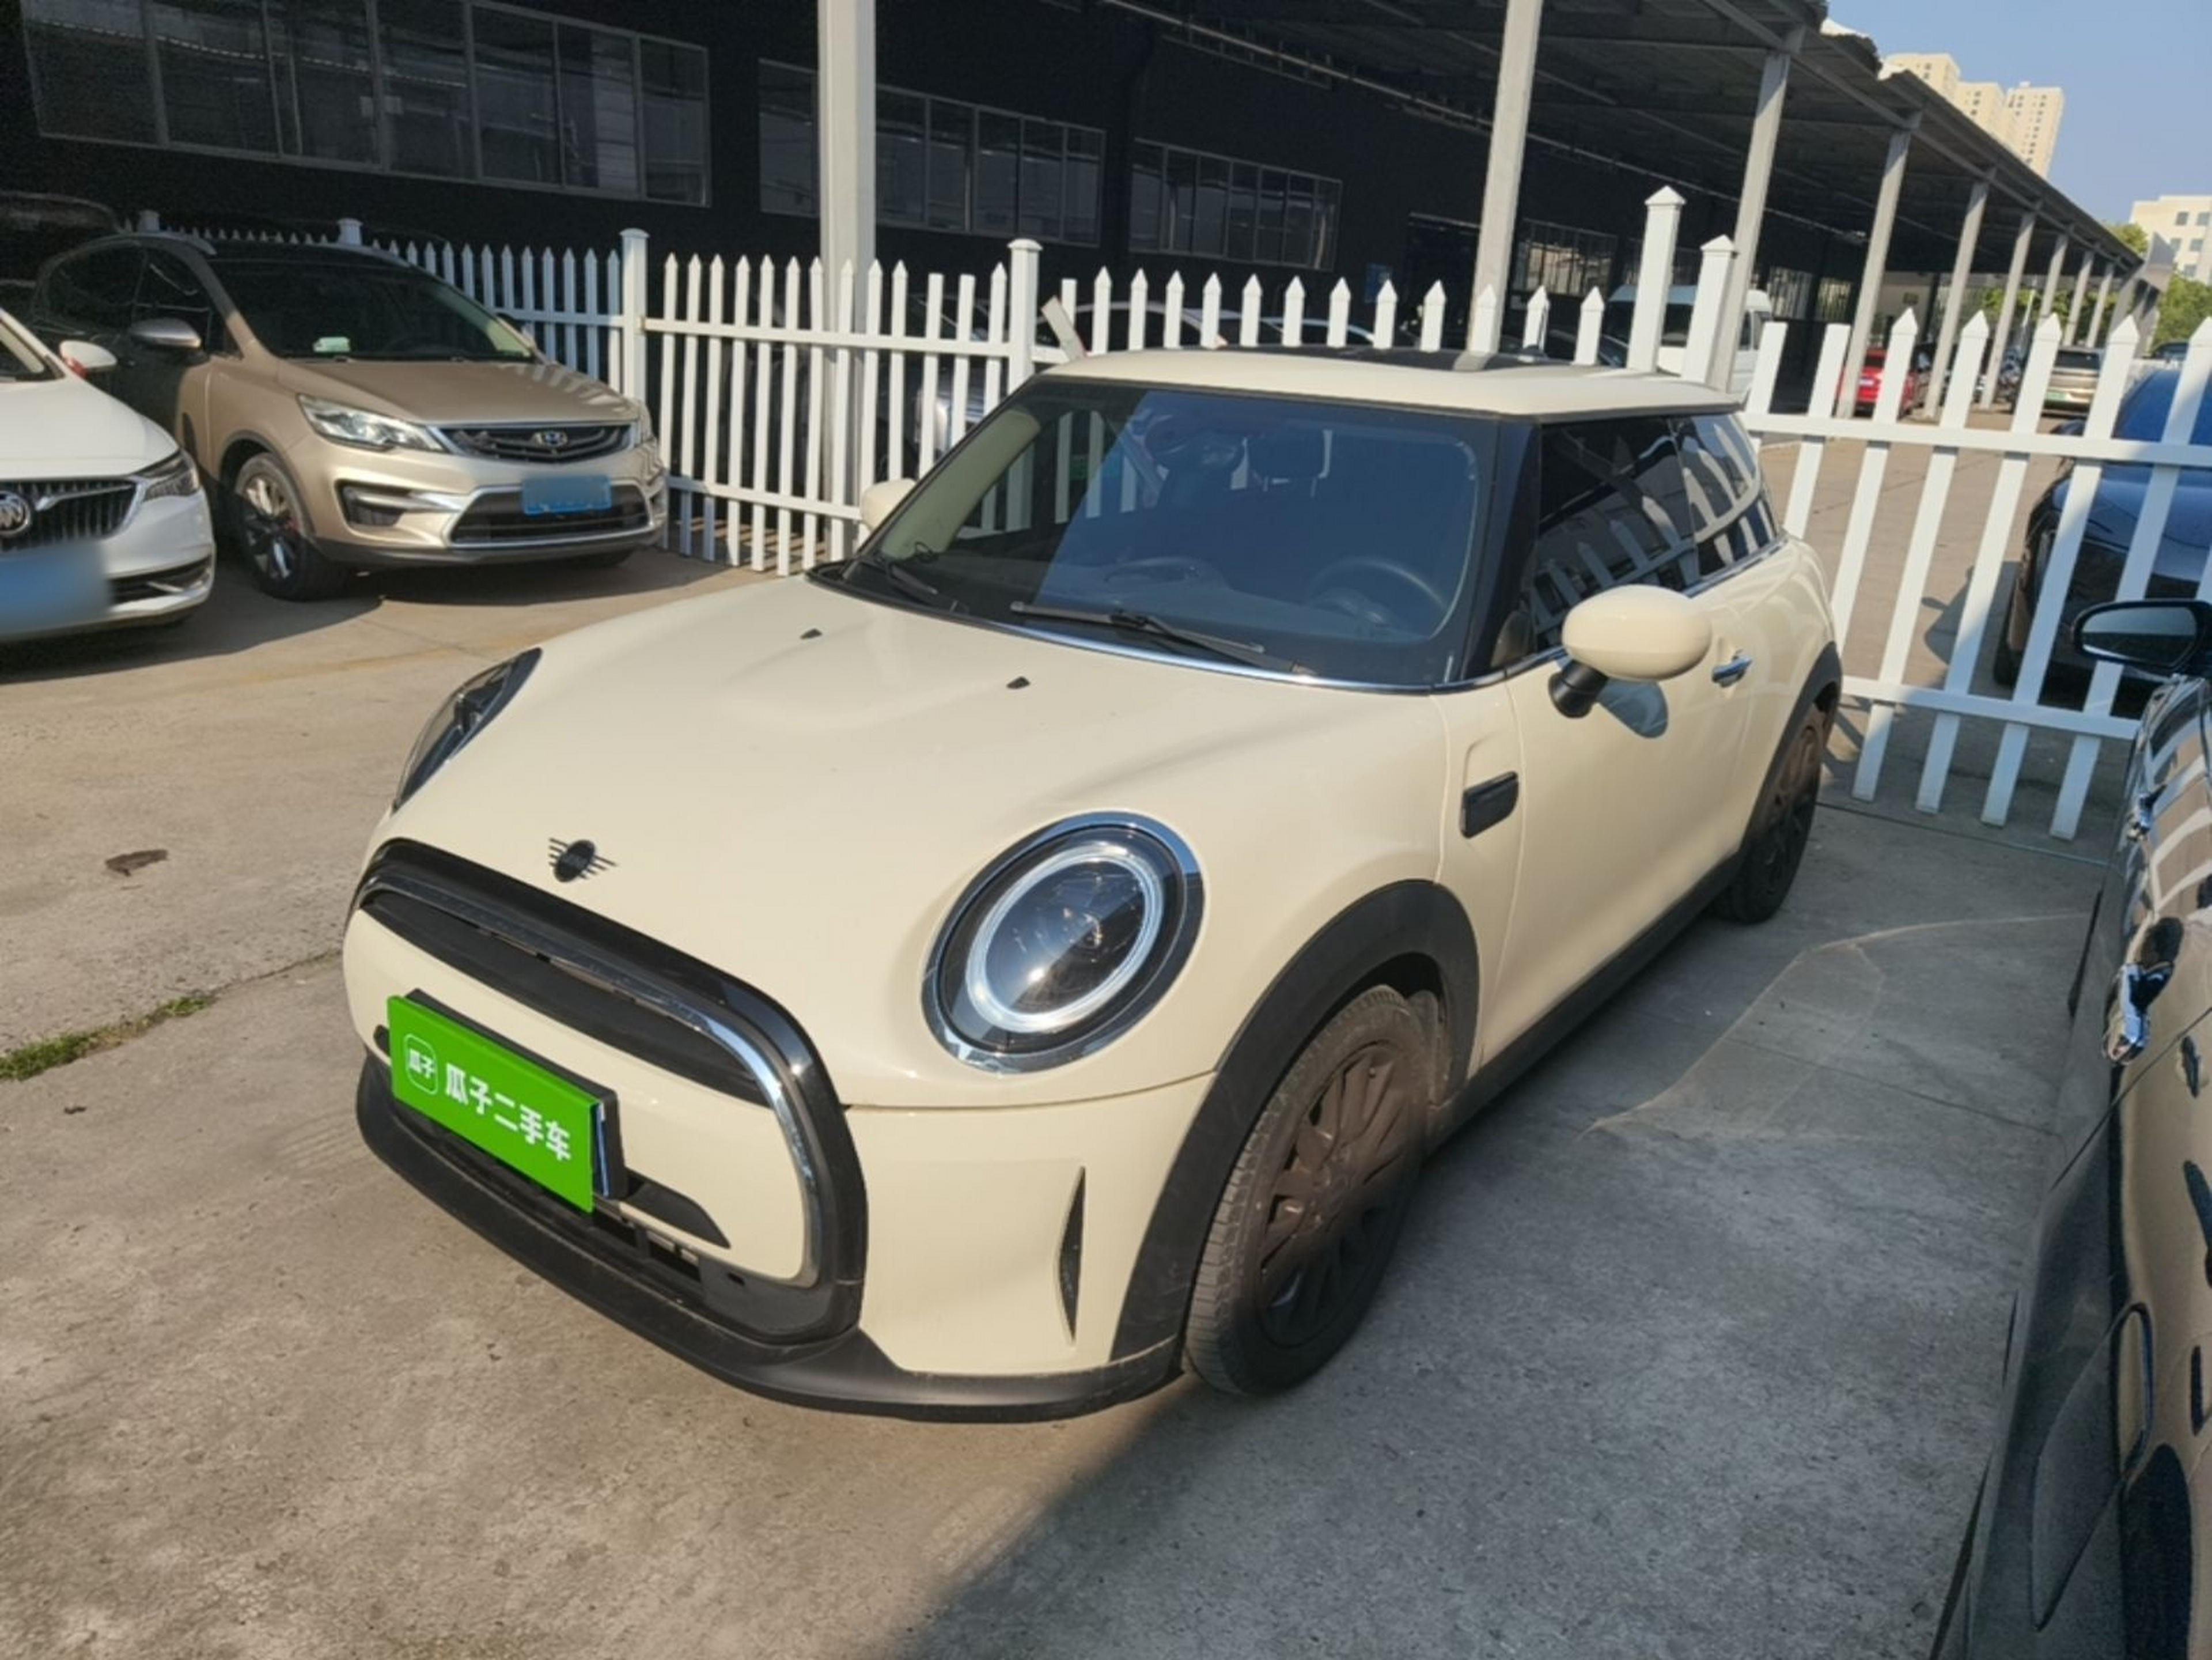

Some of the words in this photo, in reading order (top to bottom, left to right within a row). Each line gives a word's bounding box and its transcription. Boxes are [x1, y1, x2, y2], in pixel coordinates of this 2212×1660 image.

[446, 1062, 571, 1161] 瓜子二手车
